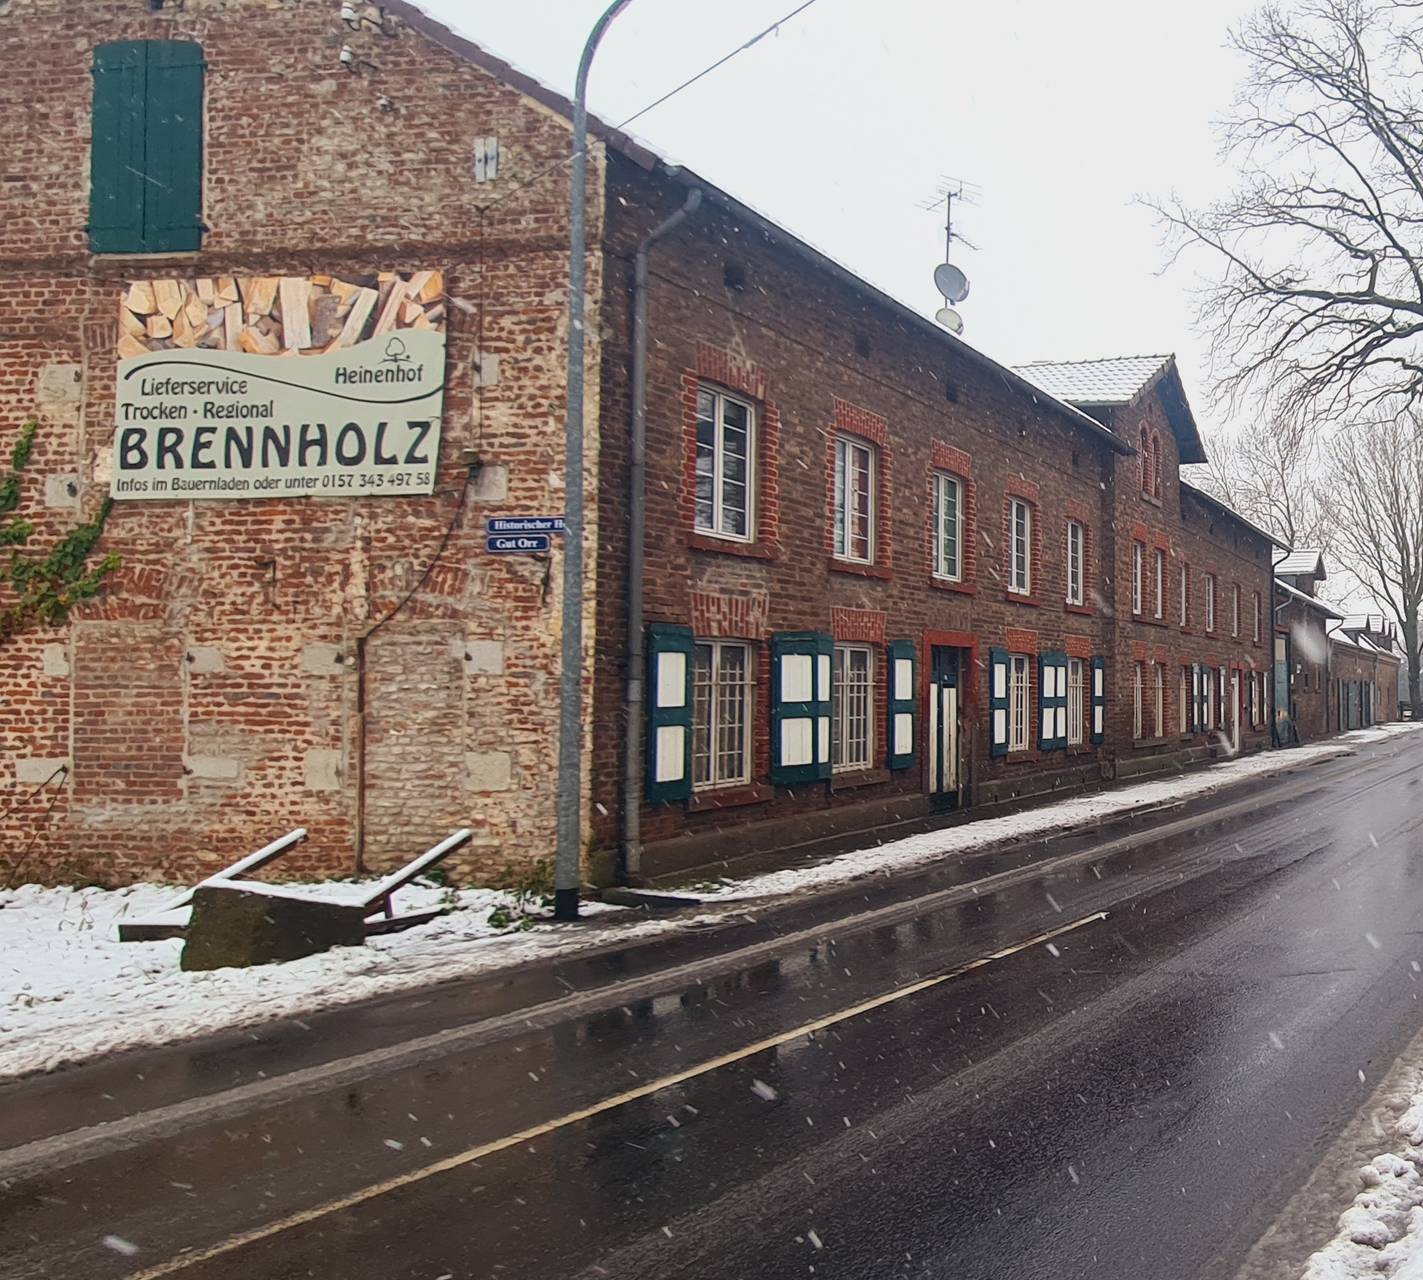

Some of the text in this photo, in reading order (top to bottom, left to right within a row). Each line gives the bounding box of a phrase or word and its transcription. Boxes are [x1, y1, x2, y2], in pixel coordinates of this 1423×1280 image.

[335, 364, 424, 385] Heinenhof
[141, 377, 248, 396] Lieferservice
[121, 400, 274, 421] Trocken Regional
[119, 421, 432, 471] BRENNHOLZ
[116, 471, 431, 492] Infos im Bauernladen oder unter 0157 343 497 58
[494, 519, 552, 530] Historischer
[496, 538, 538, 549] Gut Orr
